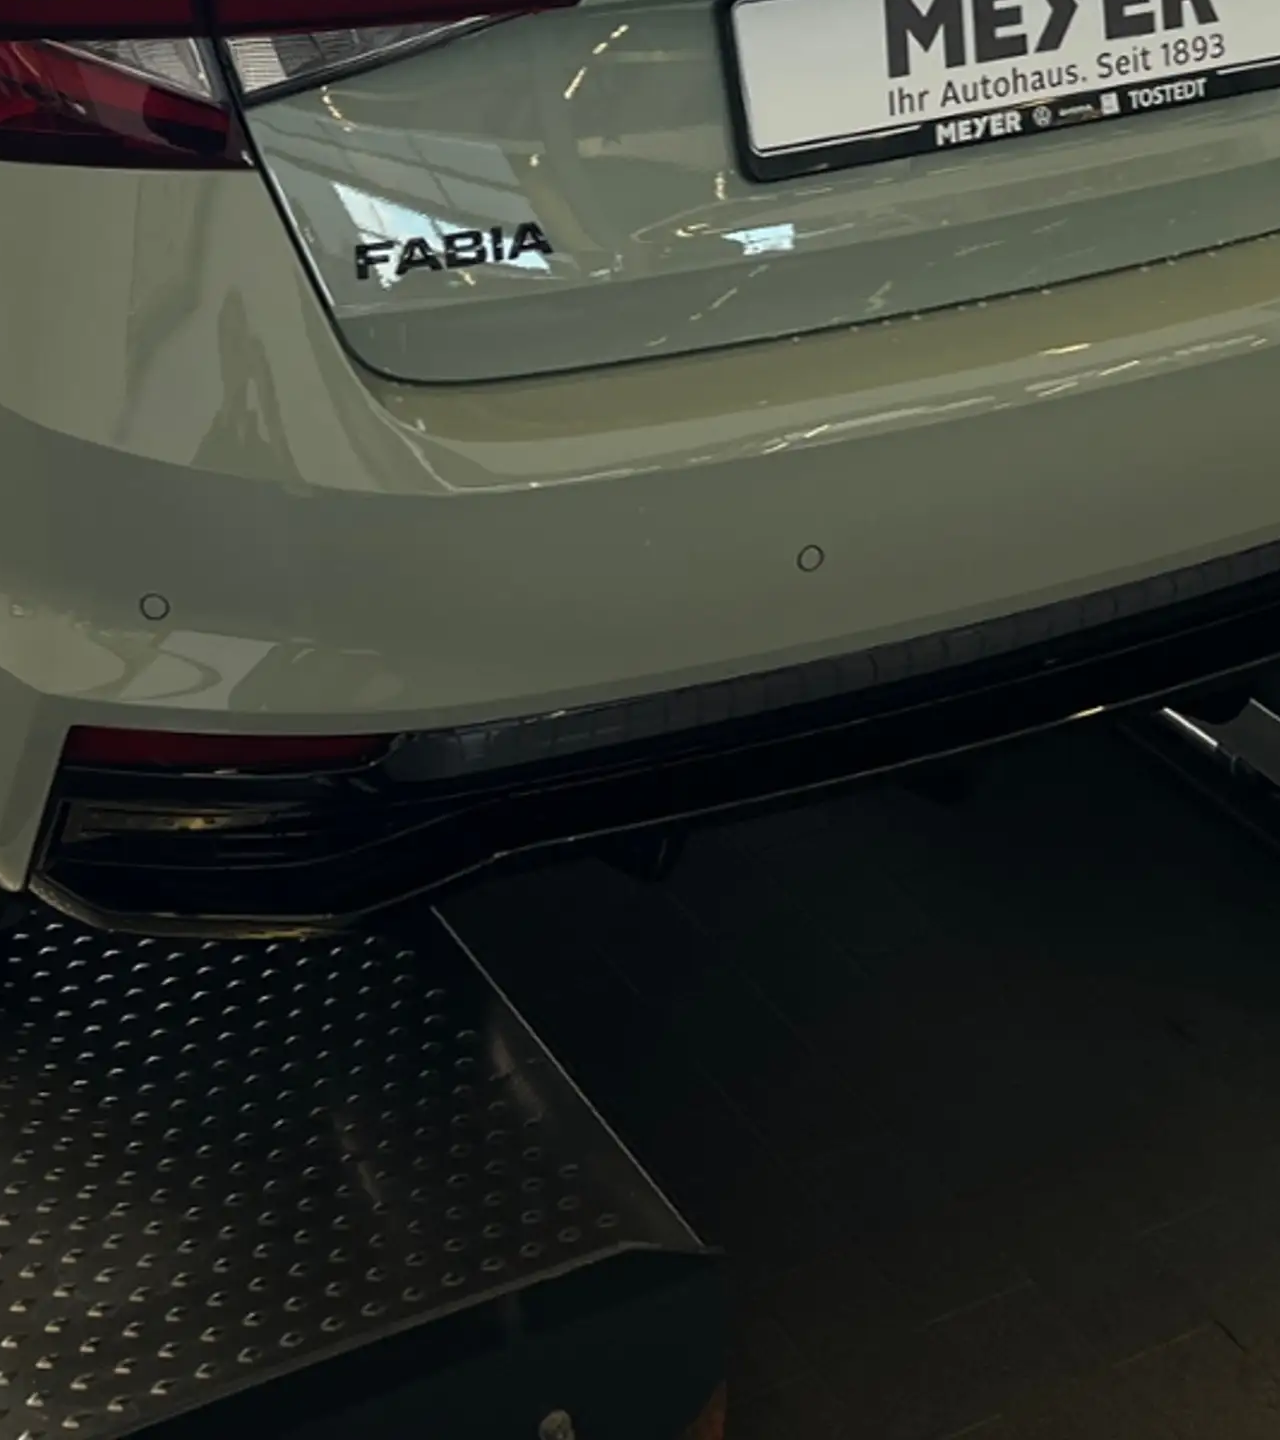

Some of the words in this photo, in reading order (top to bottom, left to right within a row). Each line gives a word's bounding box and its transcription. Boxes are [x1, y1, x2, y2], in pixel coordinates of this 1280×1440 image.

[888, 87, 930, 117] Ihr
[940, 65, 1088, 108] Autohaus.
[1096, 46, 1152, 79] Seit
[1160, 33, 1225, 67] 1893
[935, 110, 1023, 146] MEYER
[1127, 78, 1208, 109] TOSTEDT
[353, 221, 554, 280] FABIA
